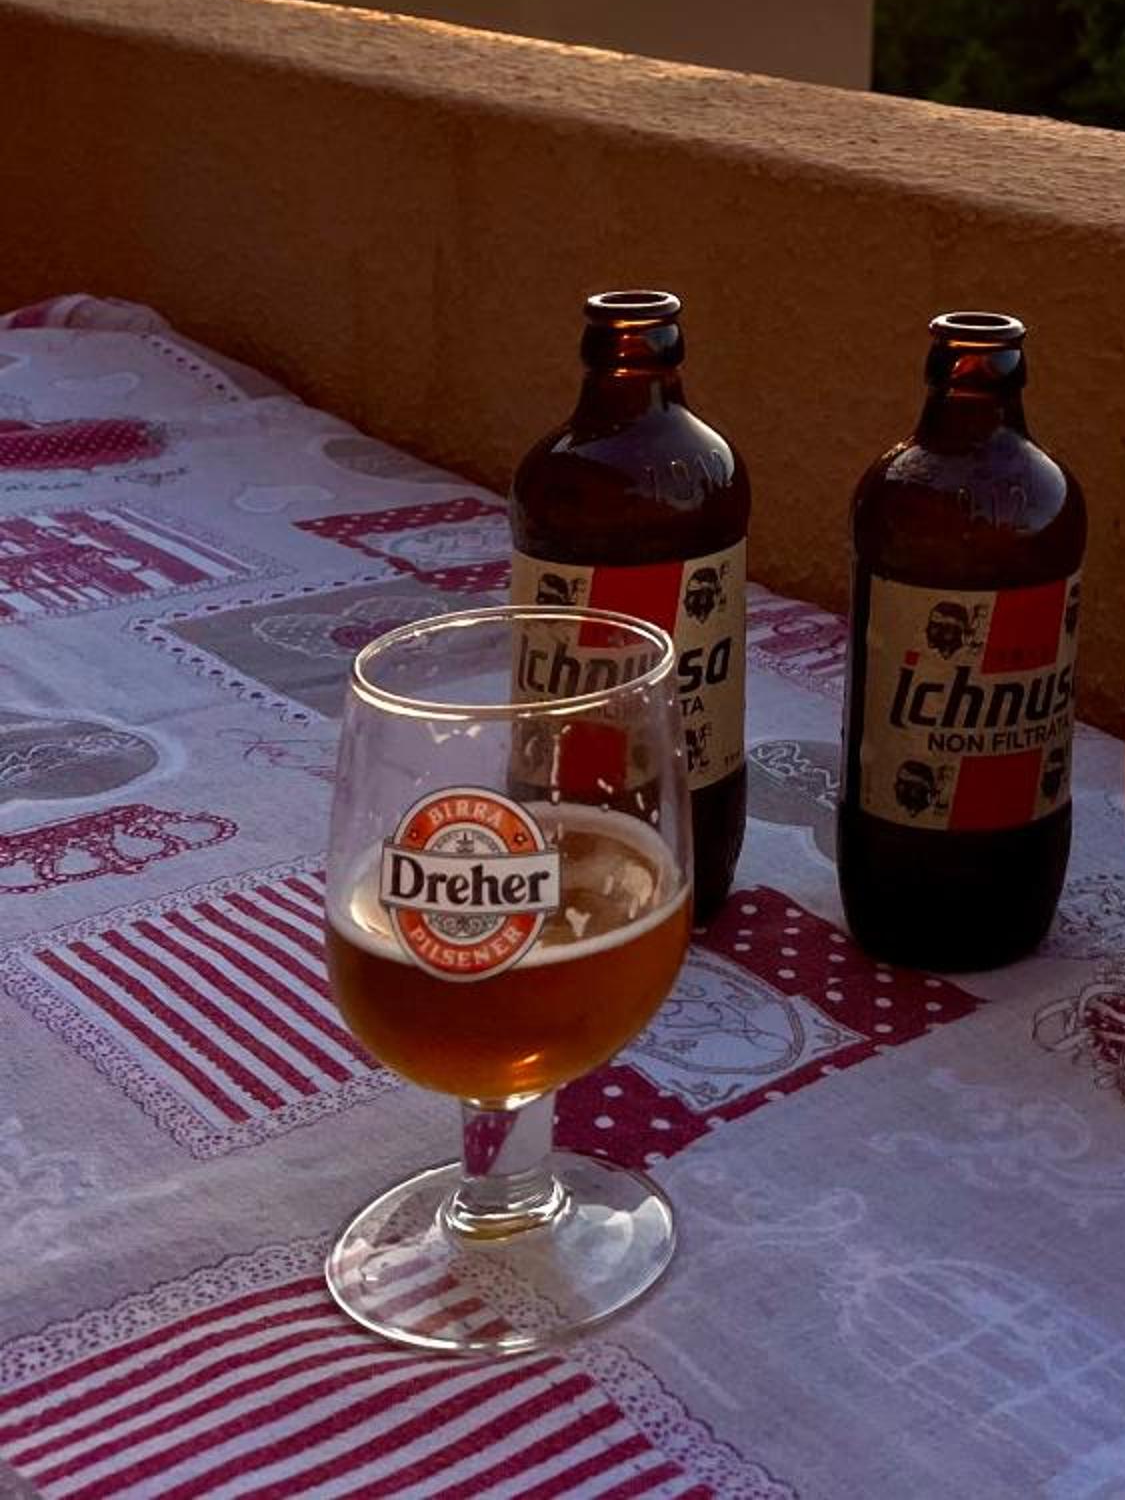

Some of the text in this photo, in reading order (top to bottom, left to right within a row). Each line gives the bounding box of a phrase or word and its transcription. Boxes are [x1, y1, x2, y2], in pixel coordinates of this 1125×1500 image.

[889, 651, 1075, 729] ichnus
[927, 732, 985, 753] NON
[429, 800, 502, 825] BIRRA
[389, 853, 550, 906] Dreher
[408, 924, 522, 967] PILSENER
